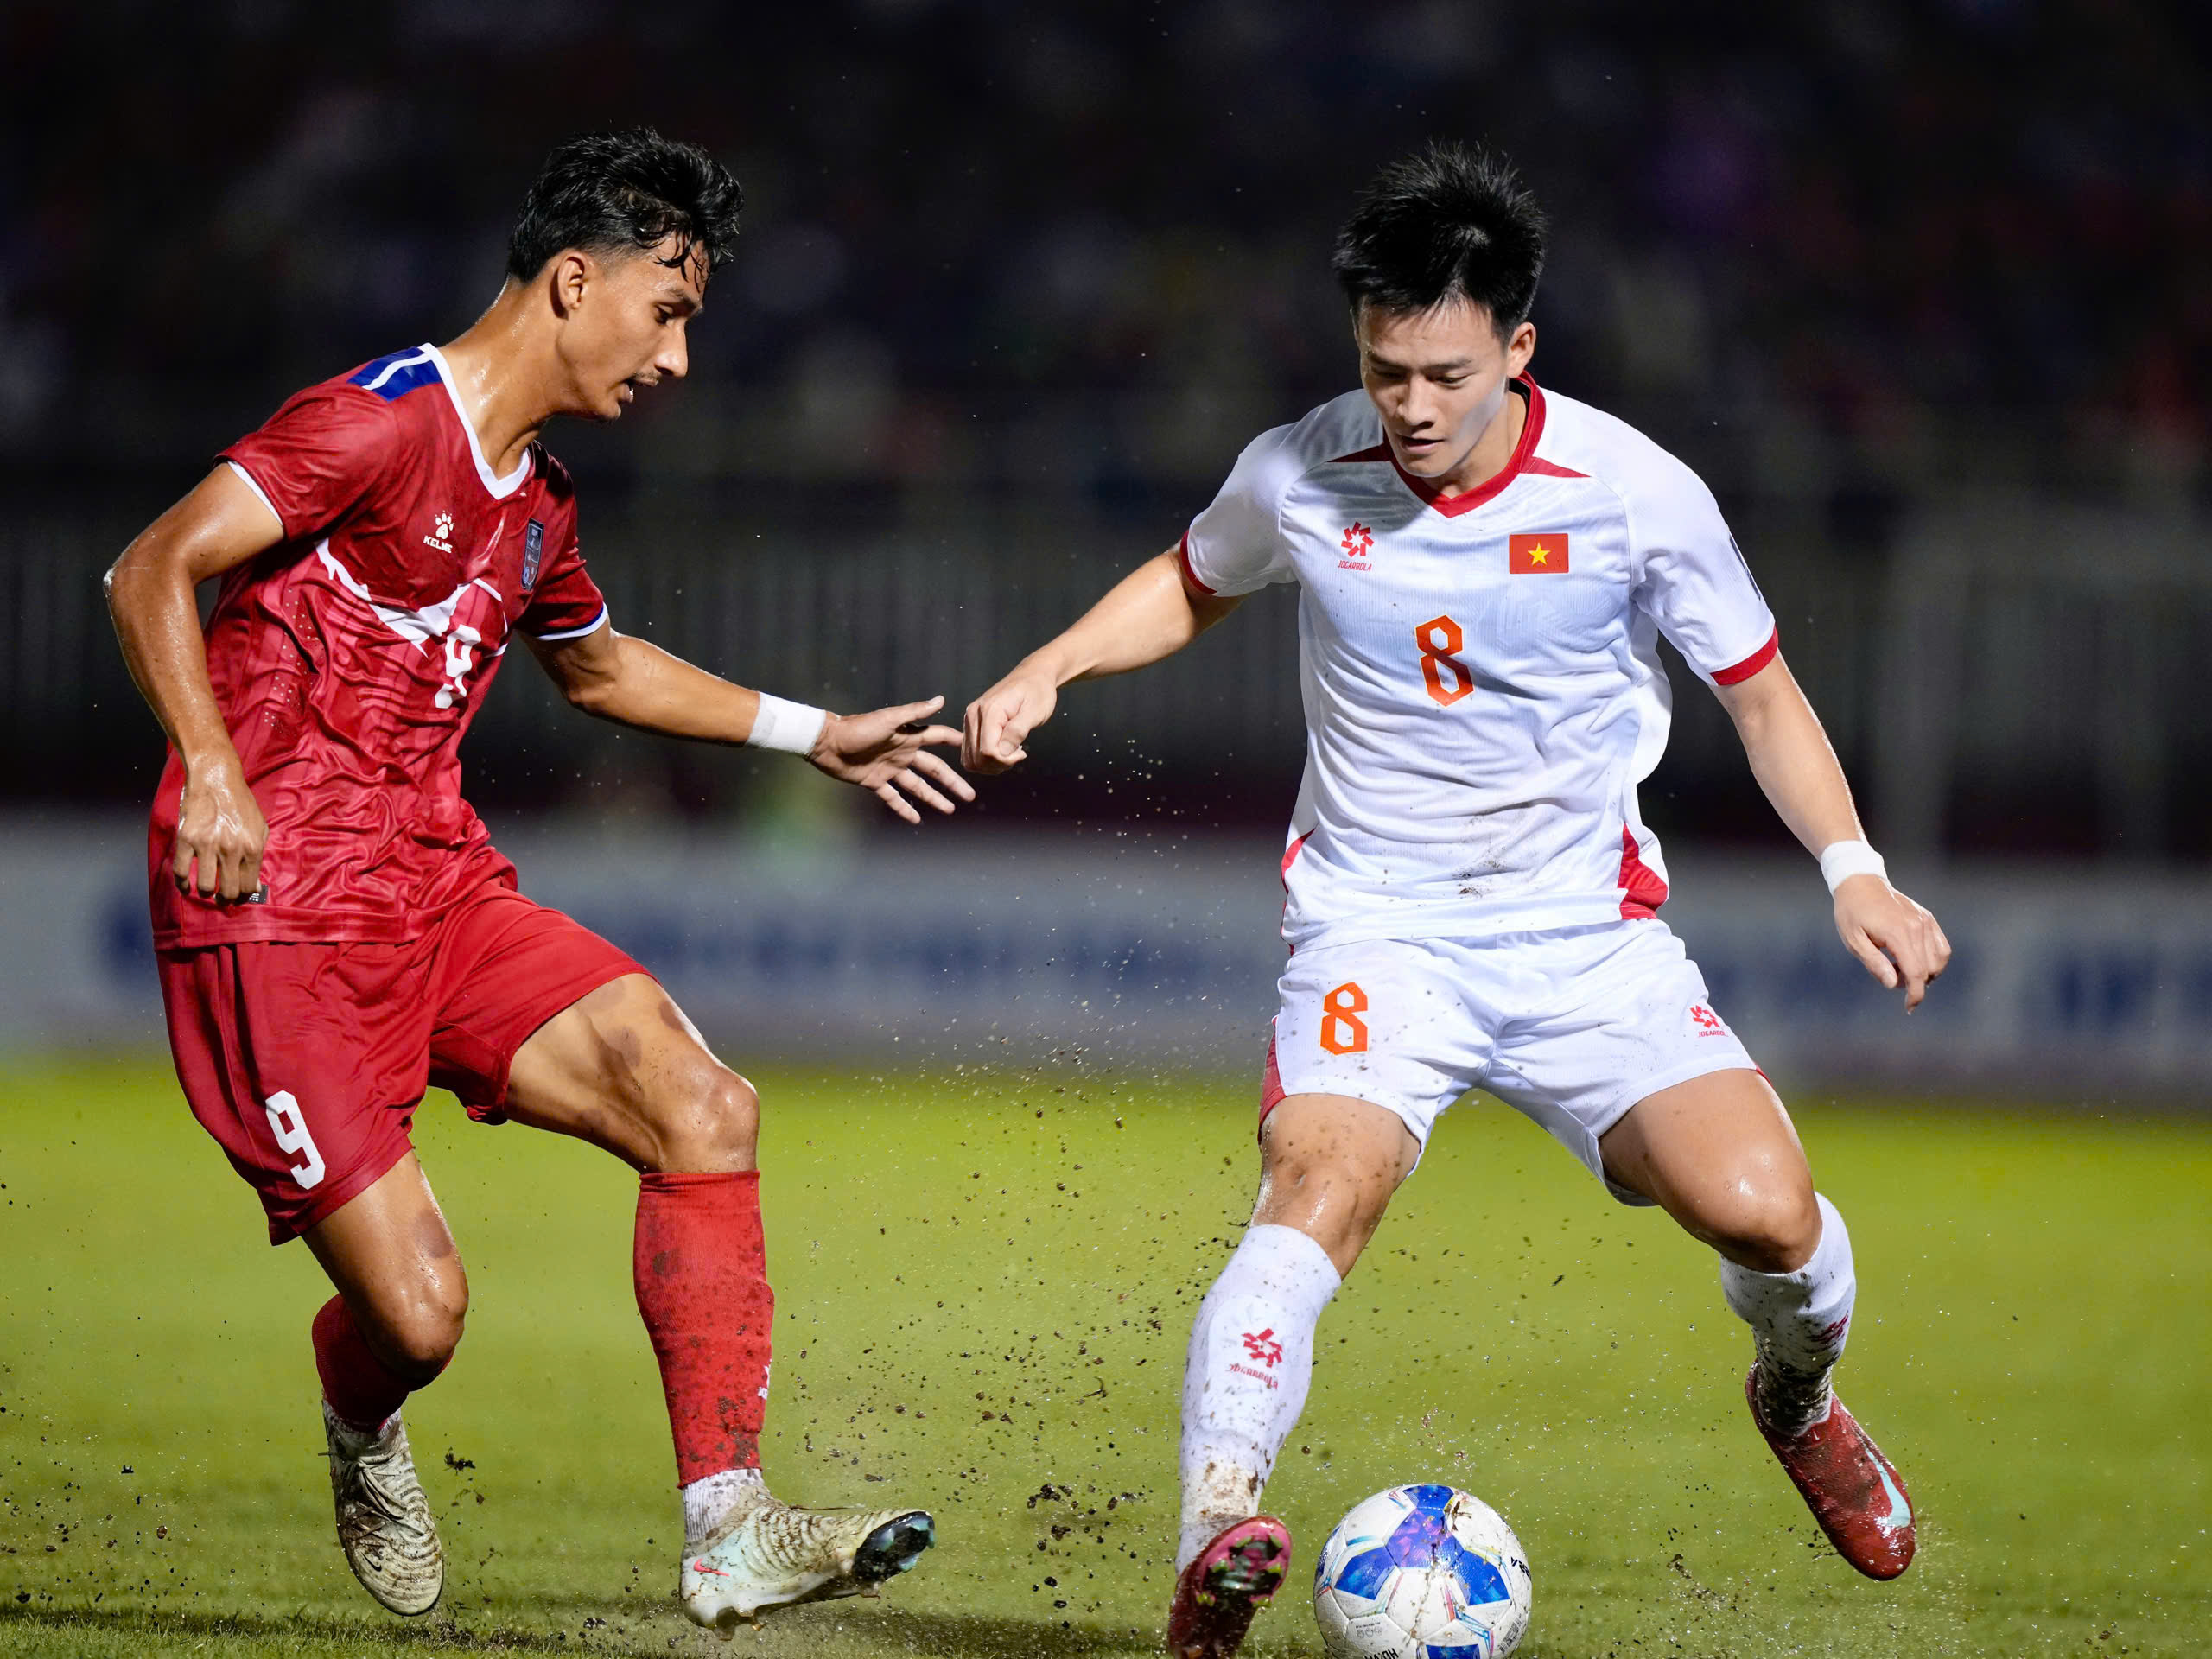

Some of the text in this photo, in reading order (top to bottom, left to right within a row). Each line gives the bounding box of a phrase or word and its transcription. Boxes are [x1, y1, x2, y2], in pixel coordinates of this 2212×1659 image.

[423, 536, 454, 553] KELME
[435, 624, 482, 709] 9
[1414, 614, 1475, 708] 8
[1319, 981, 1369, 1056] 8
[265, 1090, 326, 1190] 9
